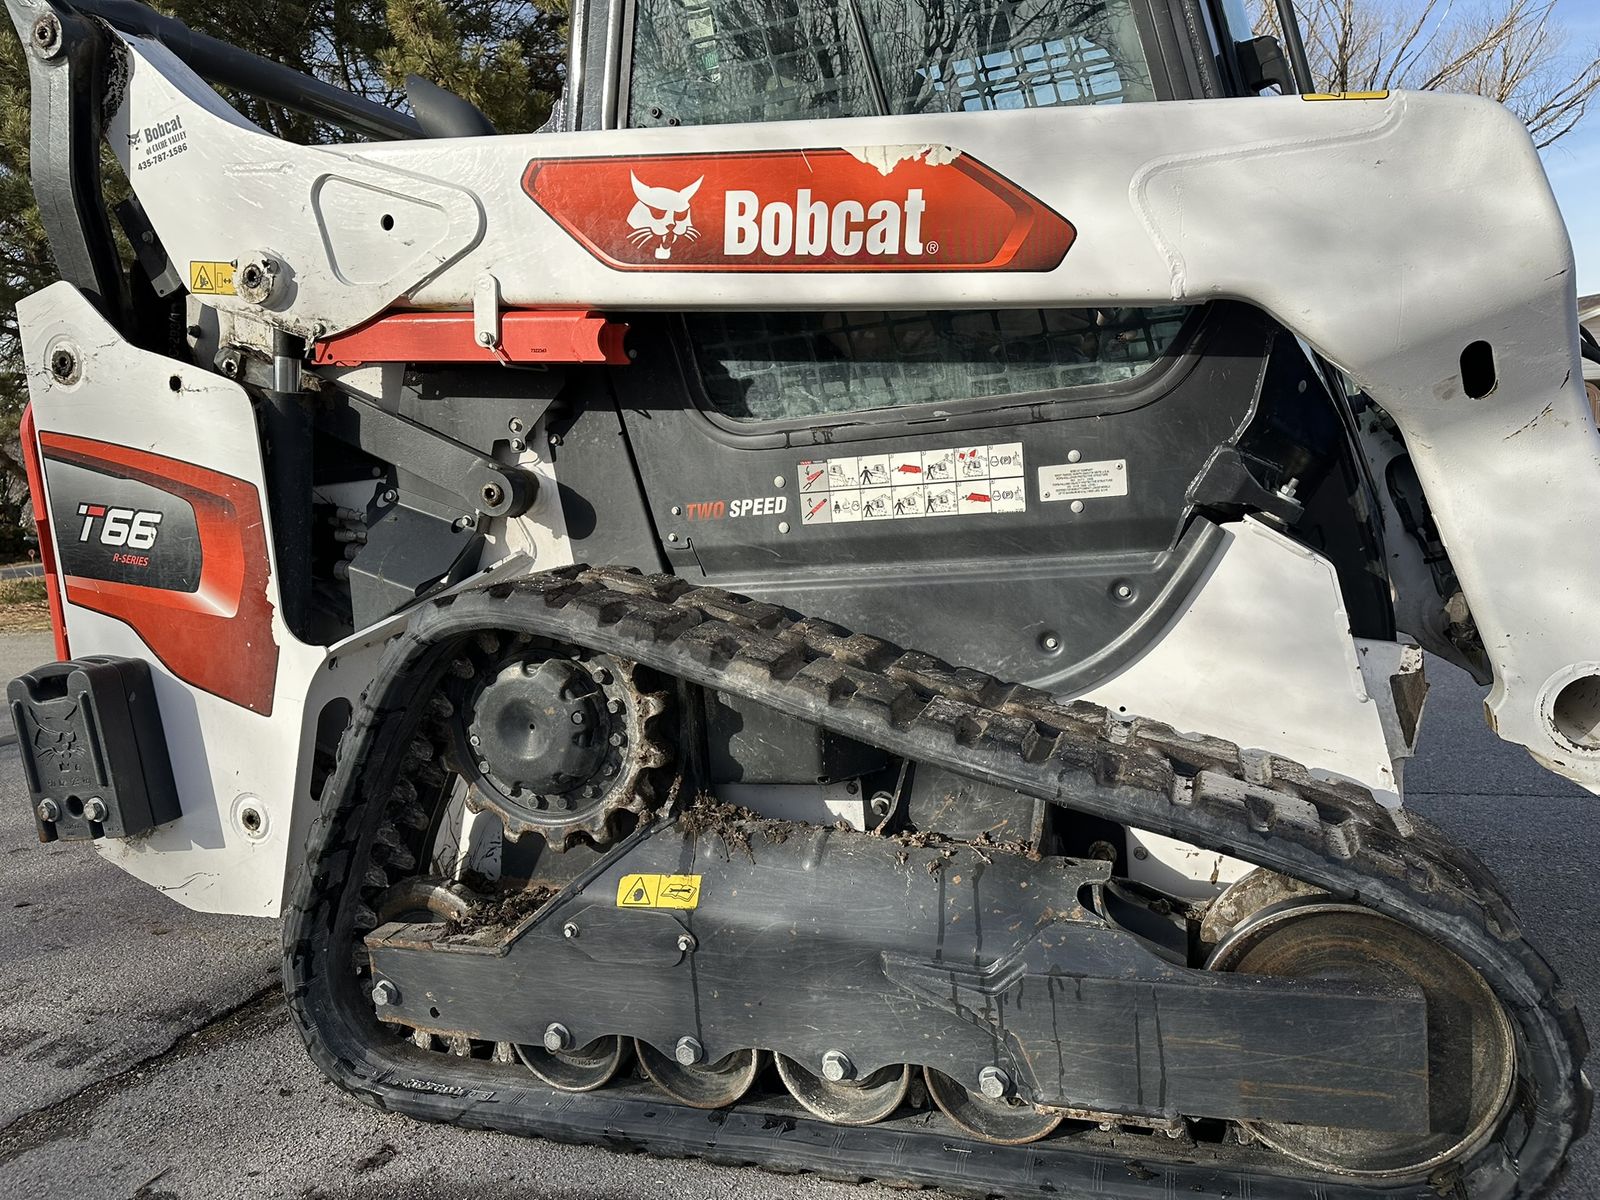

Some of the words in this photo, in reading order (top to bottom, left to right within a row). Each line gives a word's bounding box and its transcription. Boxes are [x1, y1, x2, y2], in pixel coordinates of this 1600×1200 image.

[144, 114, 183, 143] Bobcat
[168, 131, 187, 145] VALLEY
[137, 142, 188, 171] 435-787-1586
[687, 500, 726, 520] TWO
[729, 496, 787, 518] SPEED
[78, 503, 163, 550] T66
[112, 553, 149, 567] R-SERIES
